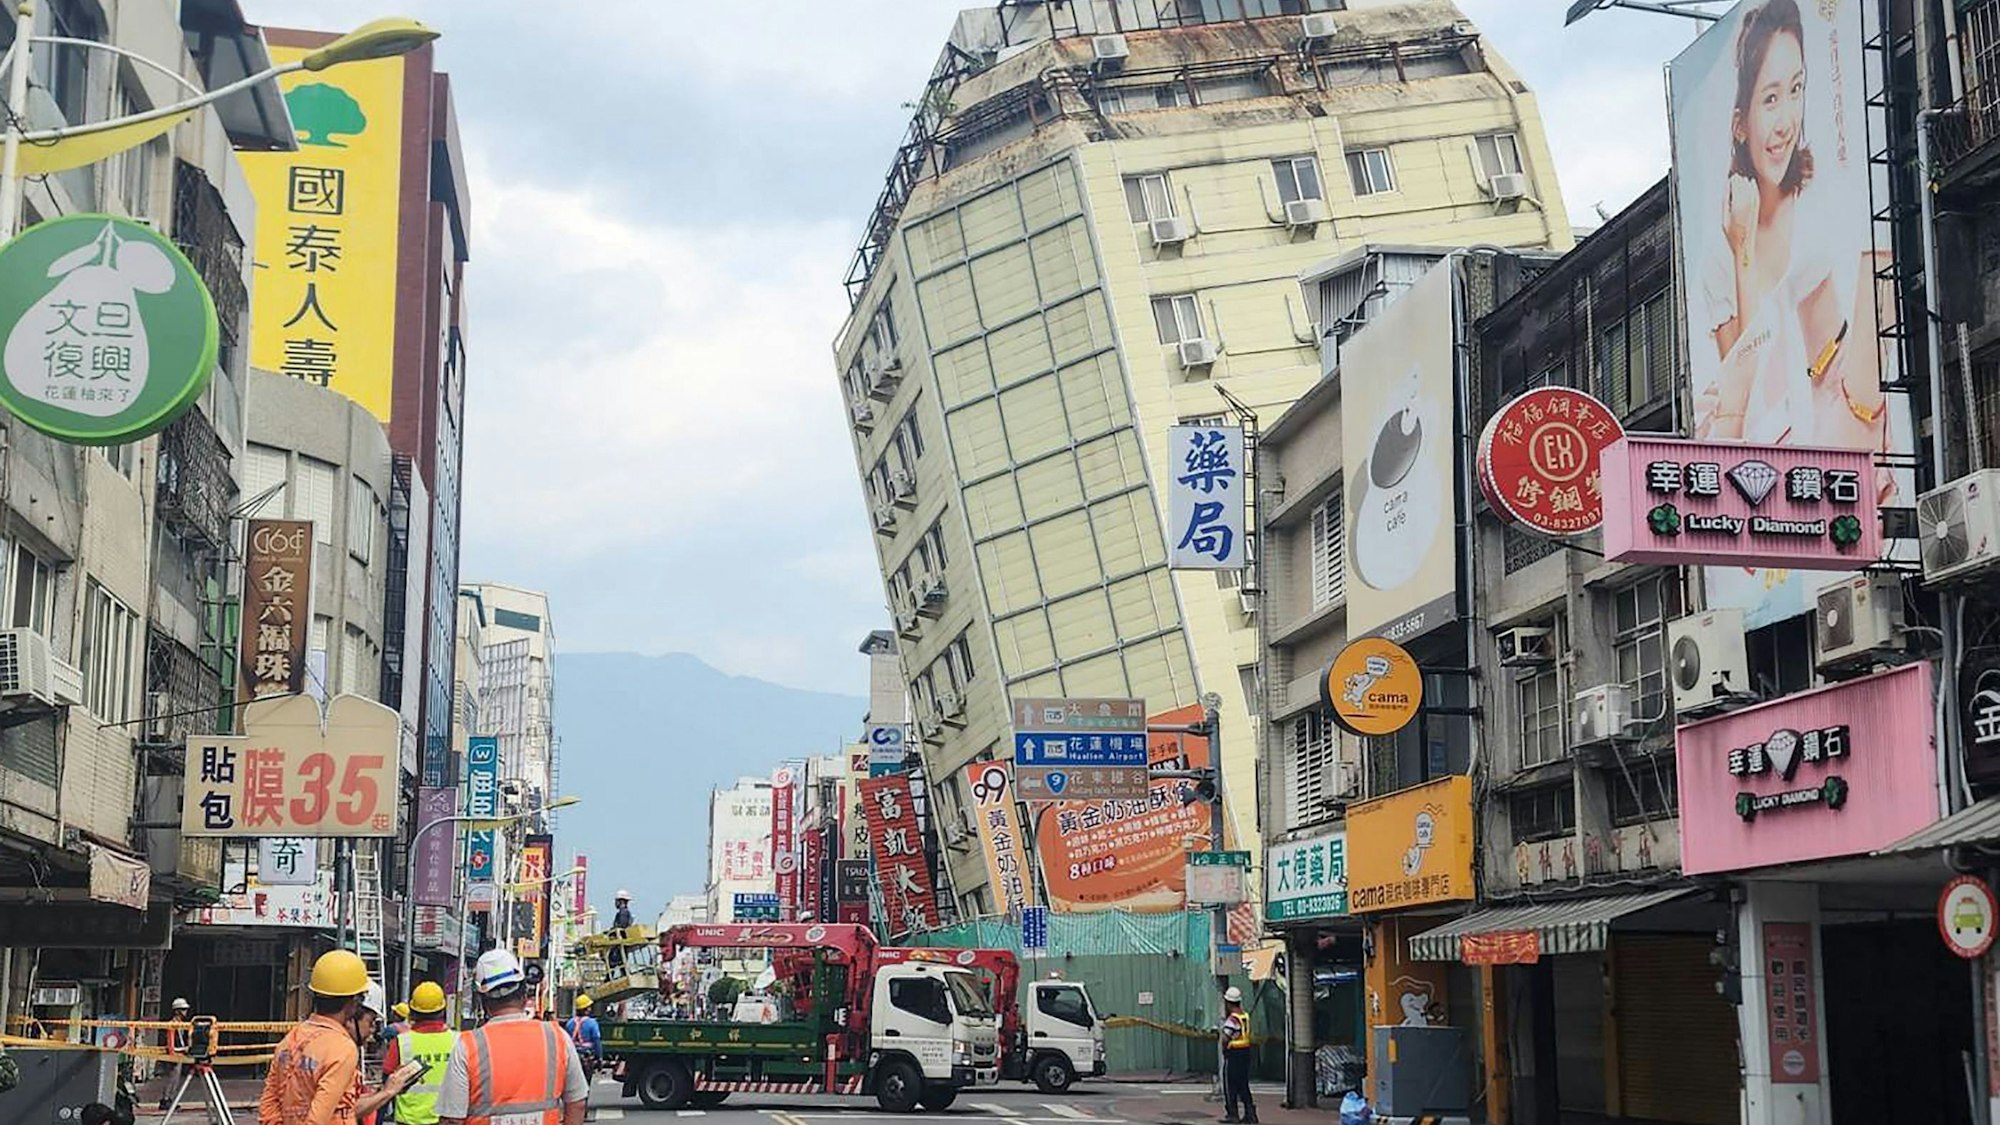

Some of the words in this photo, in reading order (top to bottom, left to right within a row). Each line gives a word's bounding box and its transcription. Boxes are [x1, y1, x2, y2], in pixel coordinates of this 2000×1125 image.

[280, 166, 345, 387] 國泰人壽
[45, 299, 134, 338] 文旦
[43, 341, 131, 382] 復興
[44, 385, 130, 402] 花蓮柚來了
[1651, 461, 1720, 495] 幸運
[1791, 468, 1859, 502] 鑽石
[1177, 430, 1237, 562] 藥局
[1689, 515, 1744, 533] Lucky
[1753, 518, 1826, 535] Diamond
[1368, 692, 1409, 704] cama
[1070, 736, 1145, 751] 花蓮機場
[1730, 744, 1763, 774] 幸運
[1803, 727, 1842, 762] 鑽石
[1069, 752, 1105, 761] Hualien
[1108, 752, 1144, 763] Airport
[973, 768, 1007, 806] 99
[1051, 774, 1061, 787] 9
[1753, 796, 1780, 810] LUCKY
[1780, 788, 1819, 805] DIAMOND
[271, 837, 303, 876] 奇
[1282, 901, 1295, 916] TEL
[1352, 885, 1385, 909] cama
[697, 928, 725, 936] UNIC
